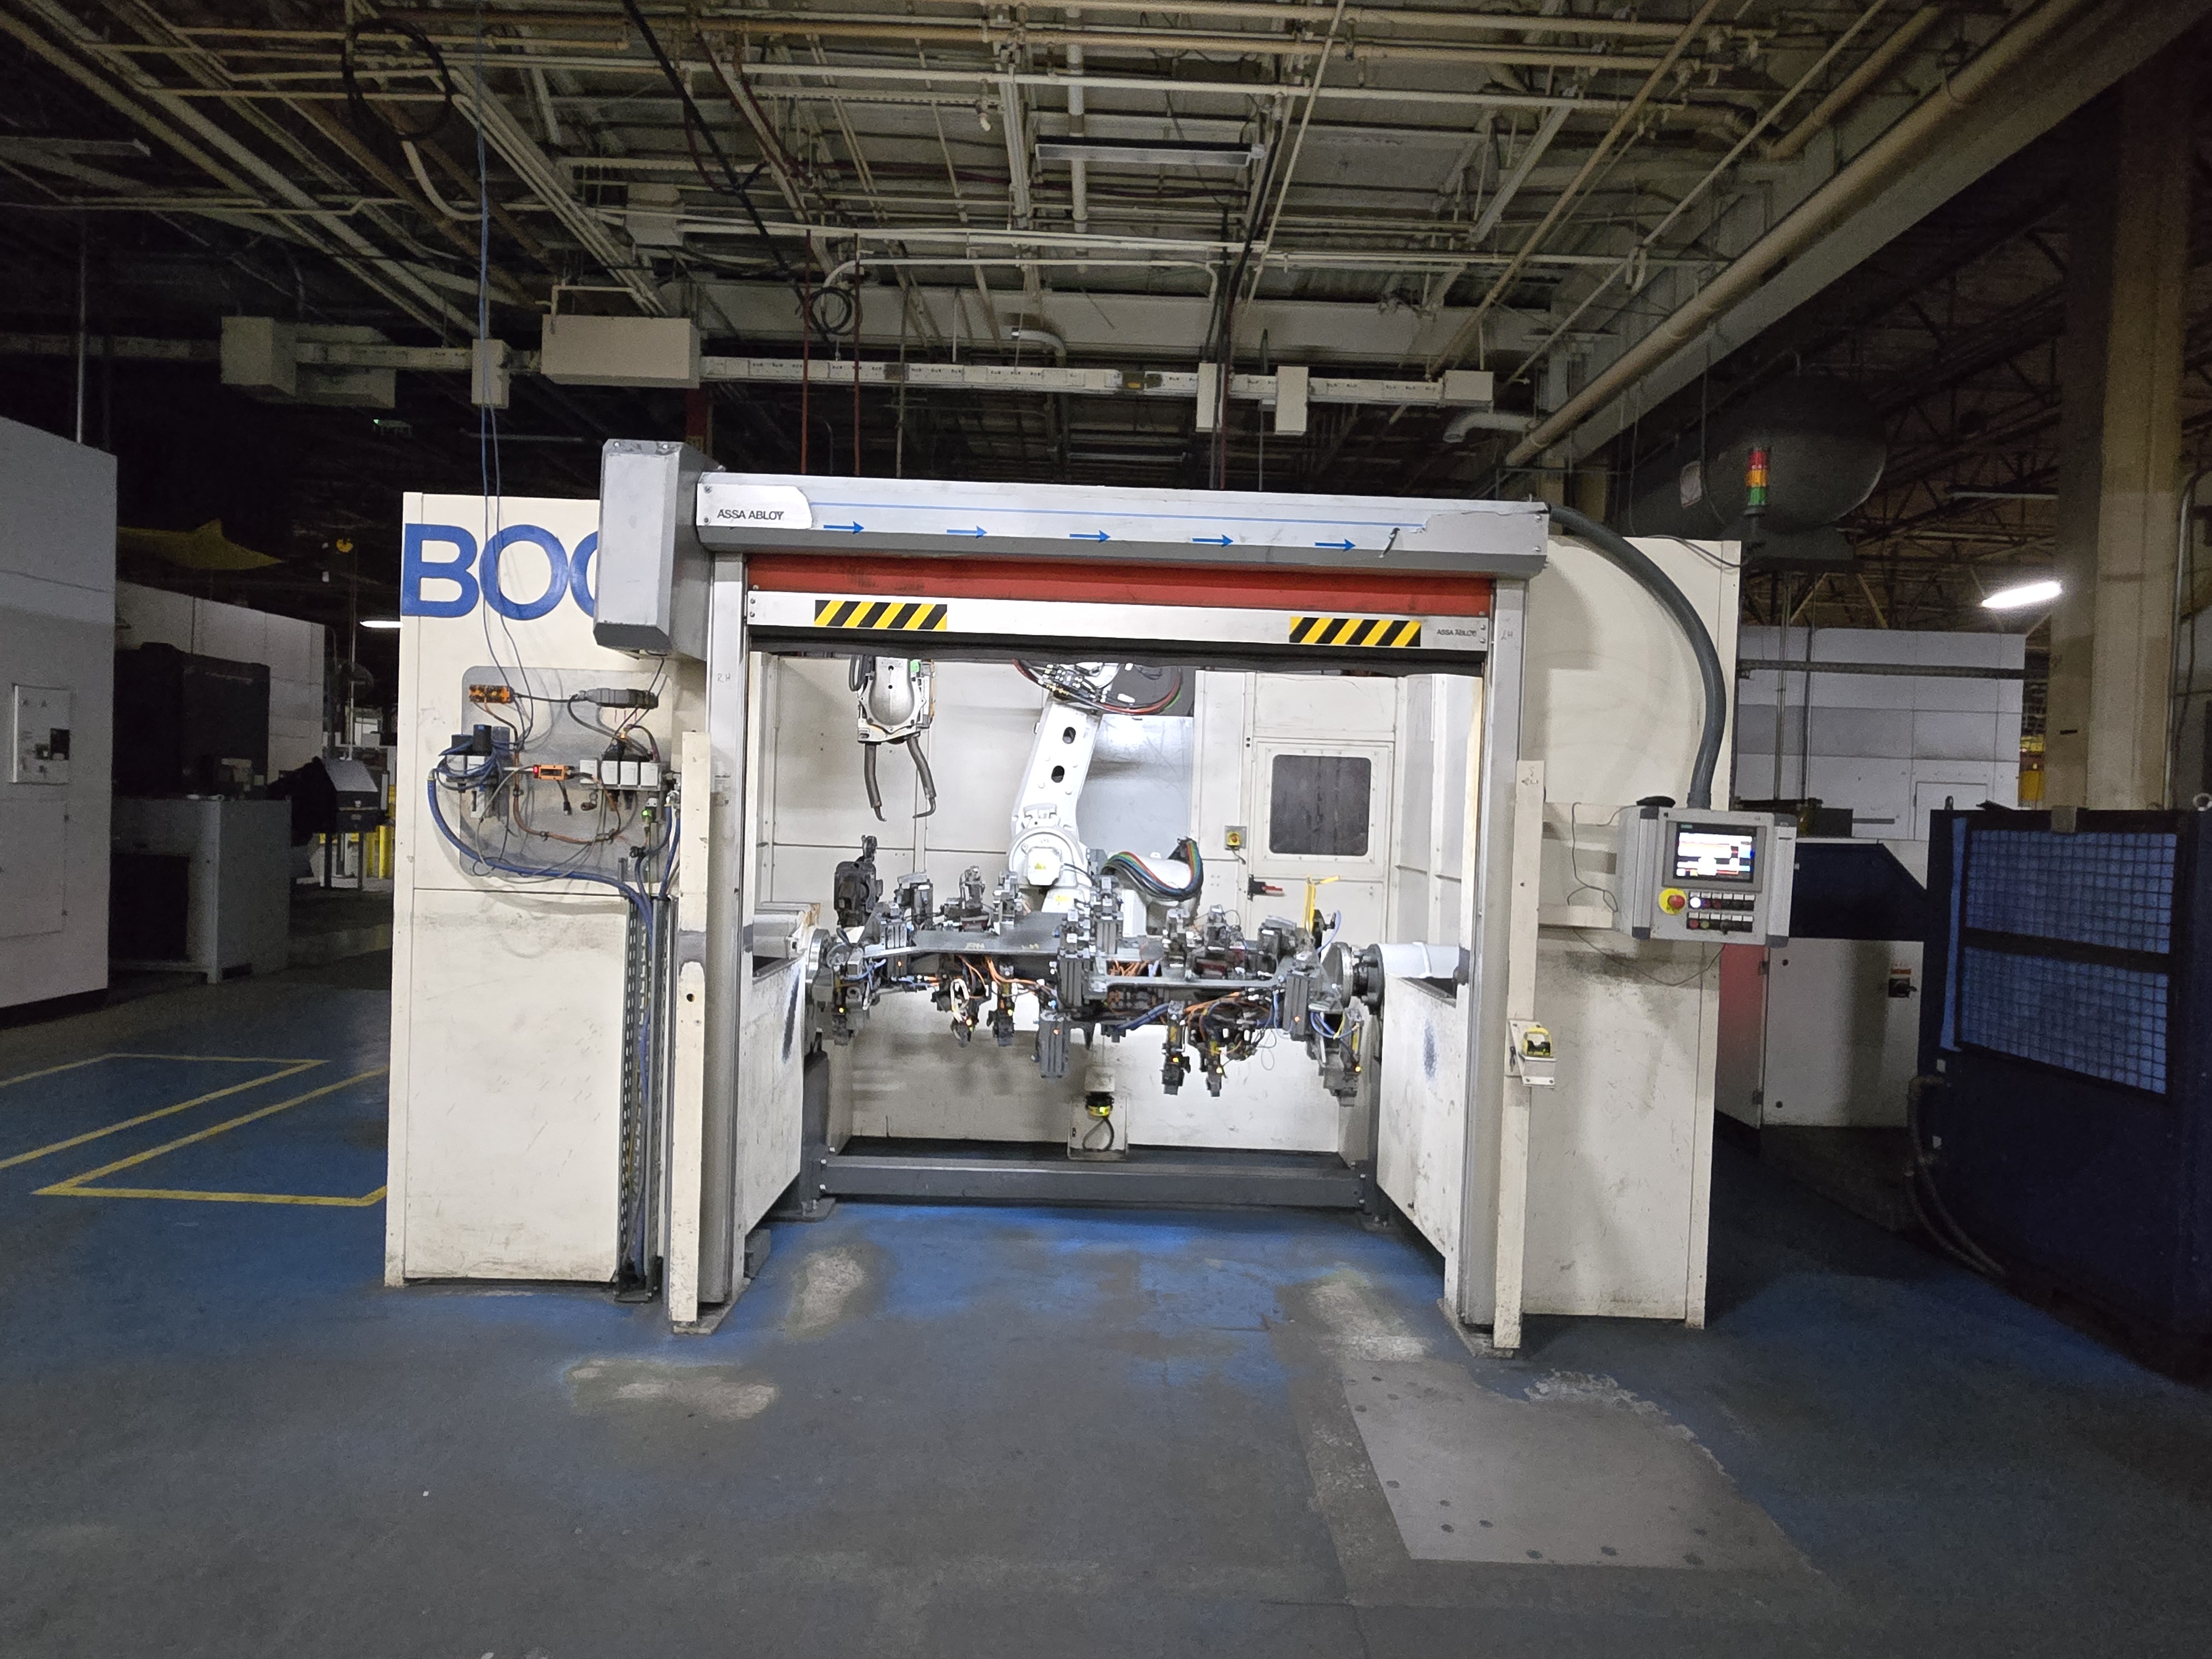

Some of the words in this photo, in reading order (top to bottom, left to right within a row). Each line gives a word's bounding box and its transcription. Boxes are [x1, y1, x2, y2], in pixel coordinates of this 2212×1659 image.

[717, 509, 746, 519] ASSA
[748, 510, 784, 520] ABLOY
[717, 672, 731, 683] RH
